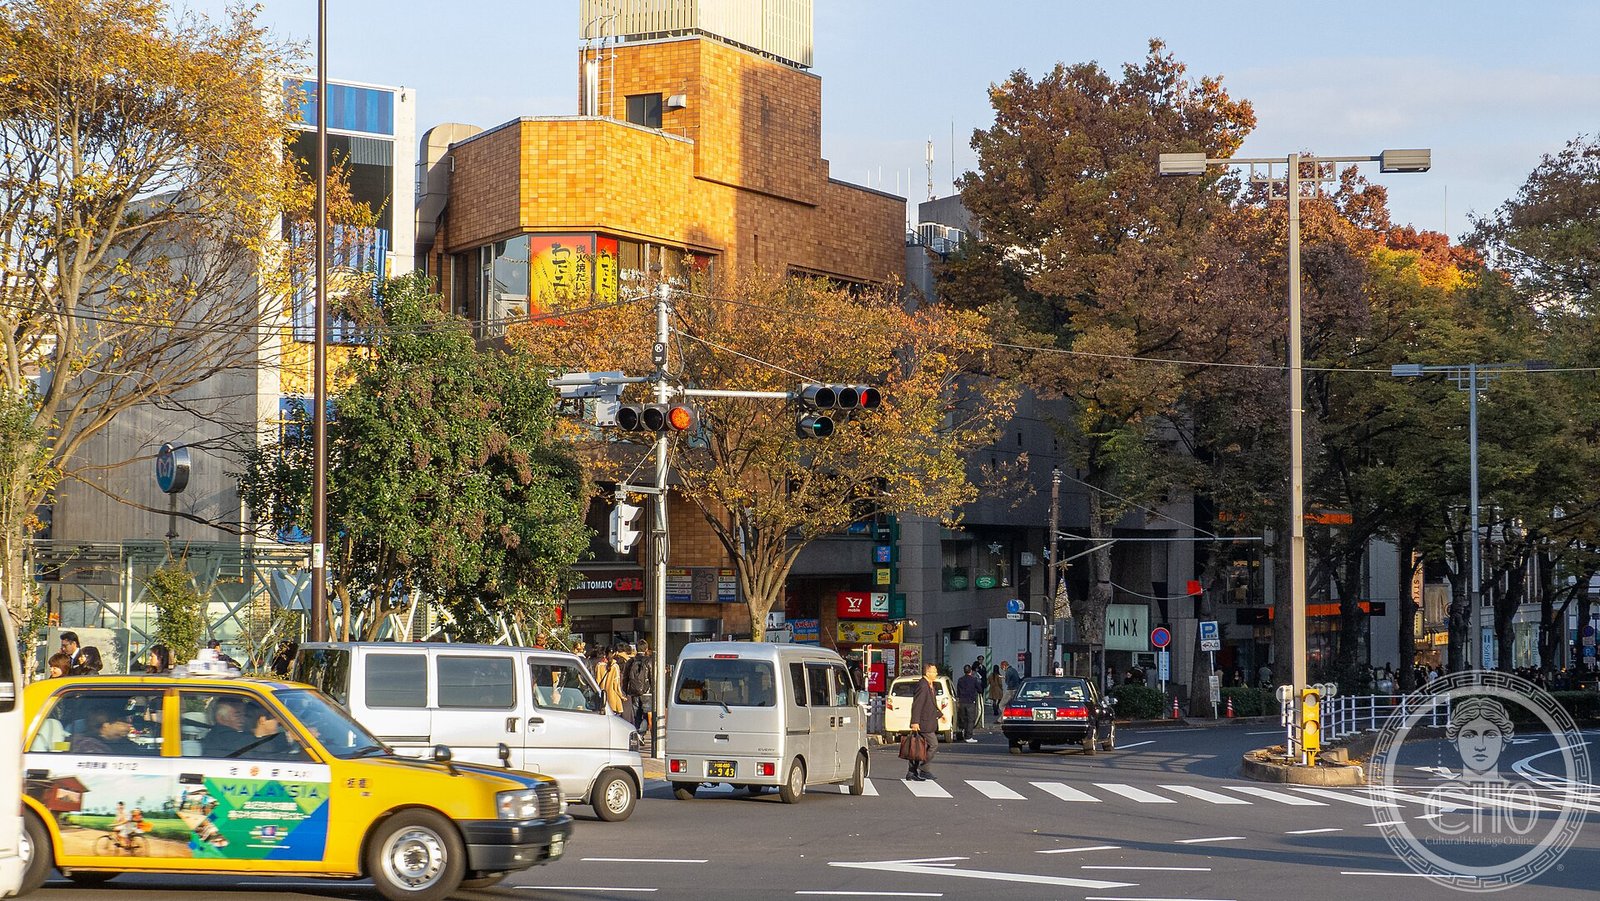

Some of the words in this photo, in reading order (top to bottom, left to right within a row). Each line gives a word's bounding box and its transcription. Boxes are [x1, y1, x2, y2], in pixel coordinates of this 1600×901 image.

[587, 580, 613, 589] TOMATO
[845, 597, 863, 608] Y!
[1109, 619, 1138, 637] MINX
[222, 784, 321, 799] MALAYSIA
